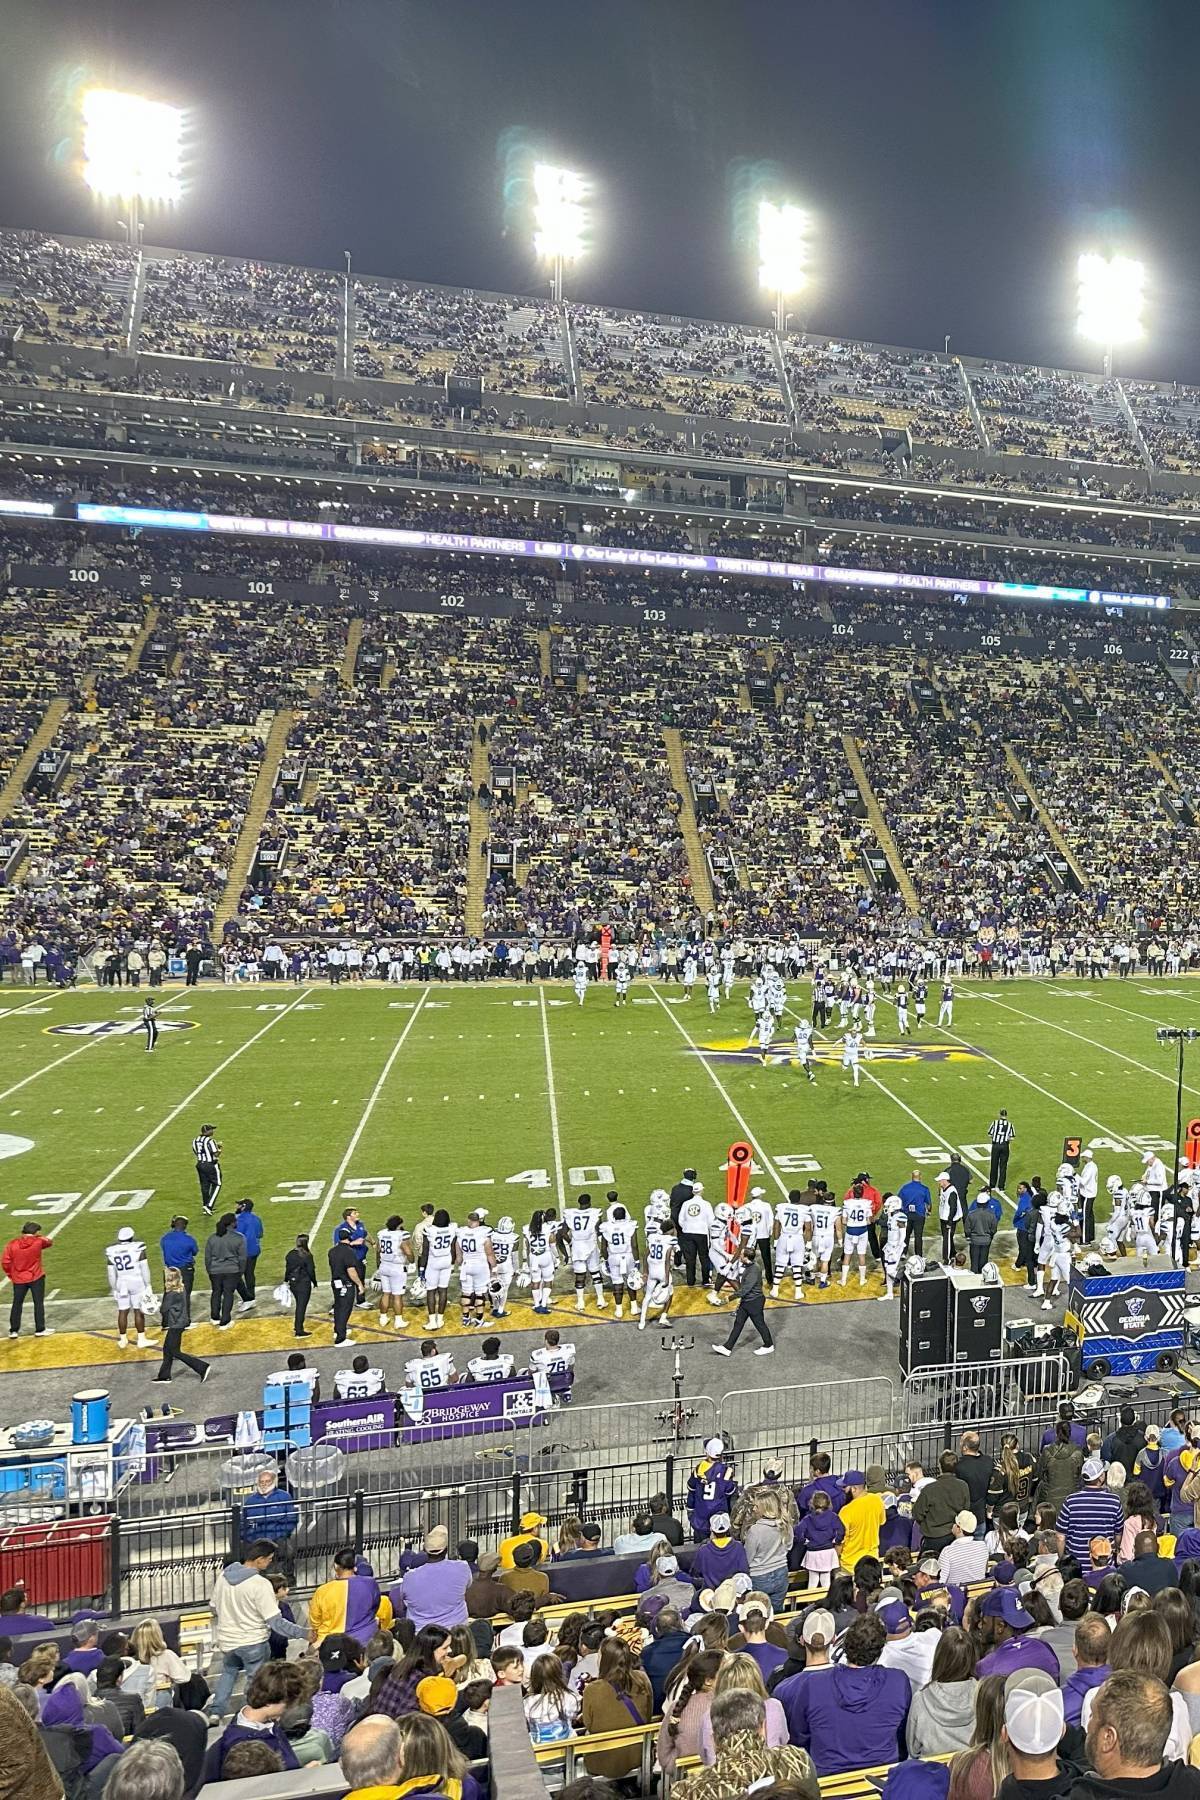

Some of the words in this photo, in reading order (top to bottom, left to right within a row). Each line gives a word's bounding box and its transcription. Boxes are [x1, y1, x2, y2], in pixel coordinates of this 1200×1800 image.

[426, 535, 467, 547] HEALTH
[471, 538, 525, 551] PARTNERS
[629, 552, 639, 561] of
[69, 570, 99, 584] 100
[899, 576, 934, 587] HEALTH
[935, 579, 980, 592] PARTNERS
[248, 581, 274, 595] 101
[440, 595, 465, 608] 102
[643, 609, 667, 622] 103
[832, 624, 855, 636] 104
[980, 636, 1001, 647] 105
[1103, 645, 1123, 655] 106
[1170, 650, 1189, 659] 222
[905, 1143, 994, 1164] 50
[1066, 1140, 1081, 1158] 3
[505, 1165, 616, 1188] 40
[270, 1177, 395, 1202] 35
[11, 1189, 157, 1216] 30
[784, 1212, 799, 1227] 78
[816, 1215, 829, 1229] 51
[850, 1209, 865, 1222] 46
[574, 1216, 590, 1231] 67
[1135, 1217, 1145, 1230] 11
[434, 1235, 451, 1250] 35
[461, 1238, 477, 1253] 60
[530, 1233, 546, 1248] 25
[612, 1232, 625, 1246] 61
[493, 1242, 509, 1256] 28
[650, 1243, 663, 1260] 38
[114, 1255, 134, 1272] 82
[1118, 1314, 1150, 1324] GEORGIA
[1123, 1321, 1146, 1330] STATE
[547, 1361, 566, 1373] 76
[420, 1368, 441, 1387] 65
[347, 1385, 368, 1398] 63
[431, 1402, 491, 1418] BRIDGEWAY
[442, 1411, 480, 1422] HOSPICE
[506, 1408, 533, 1416] RENTALS
[325, 1413, 384, 1430] SouthernAIR
[703, 1481, 717, 1500] 9
[1018, 1475, 1029, 1501] 9
